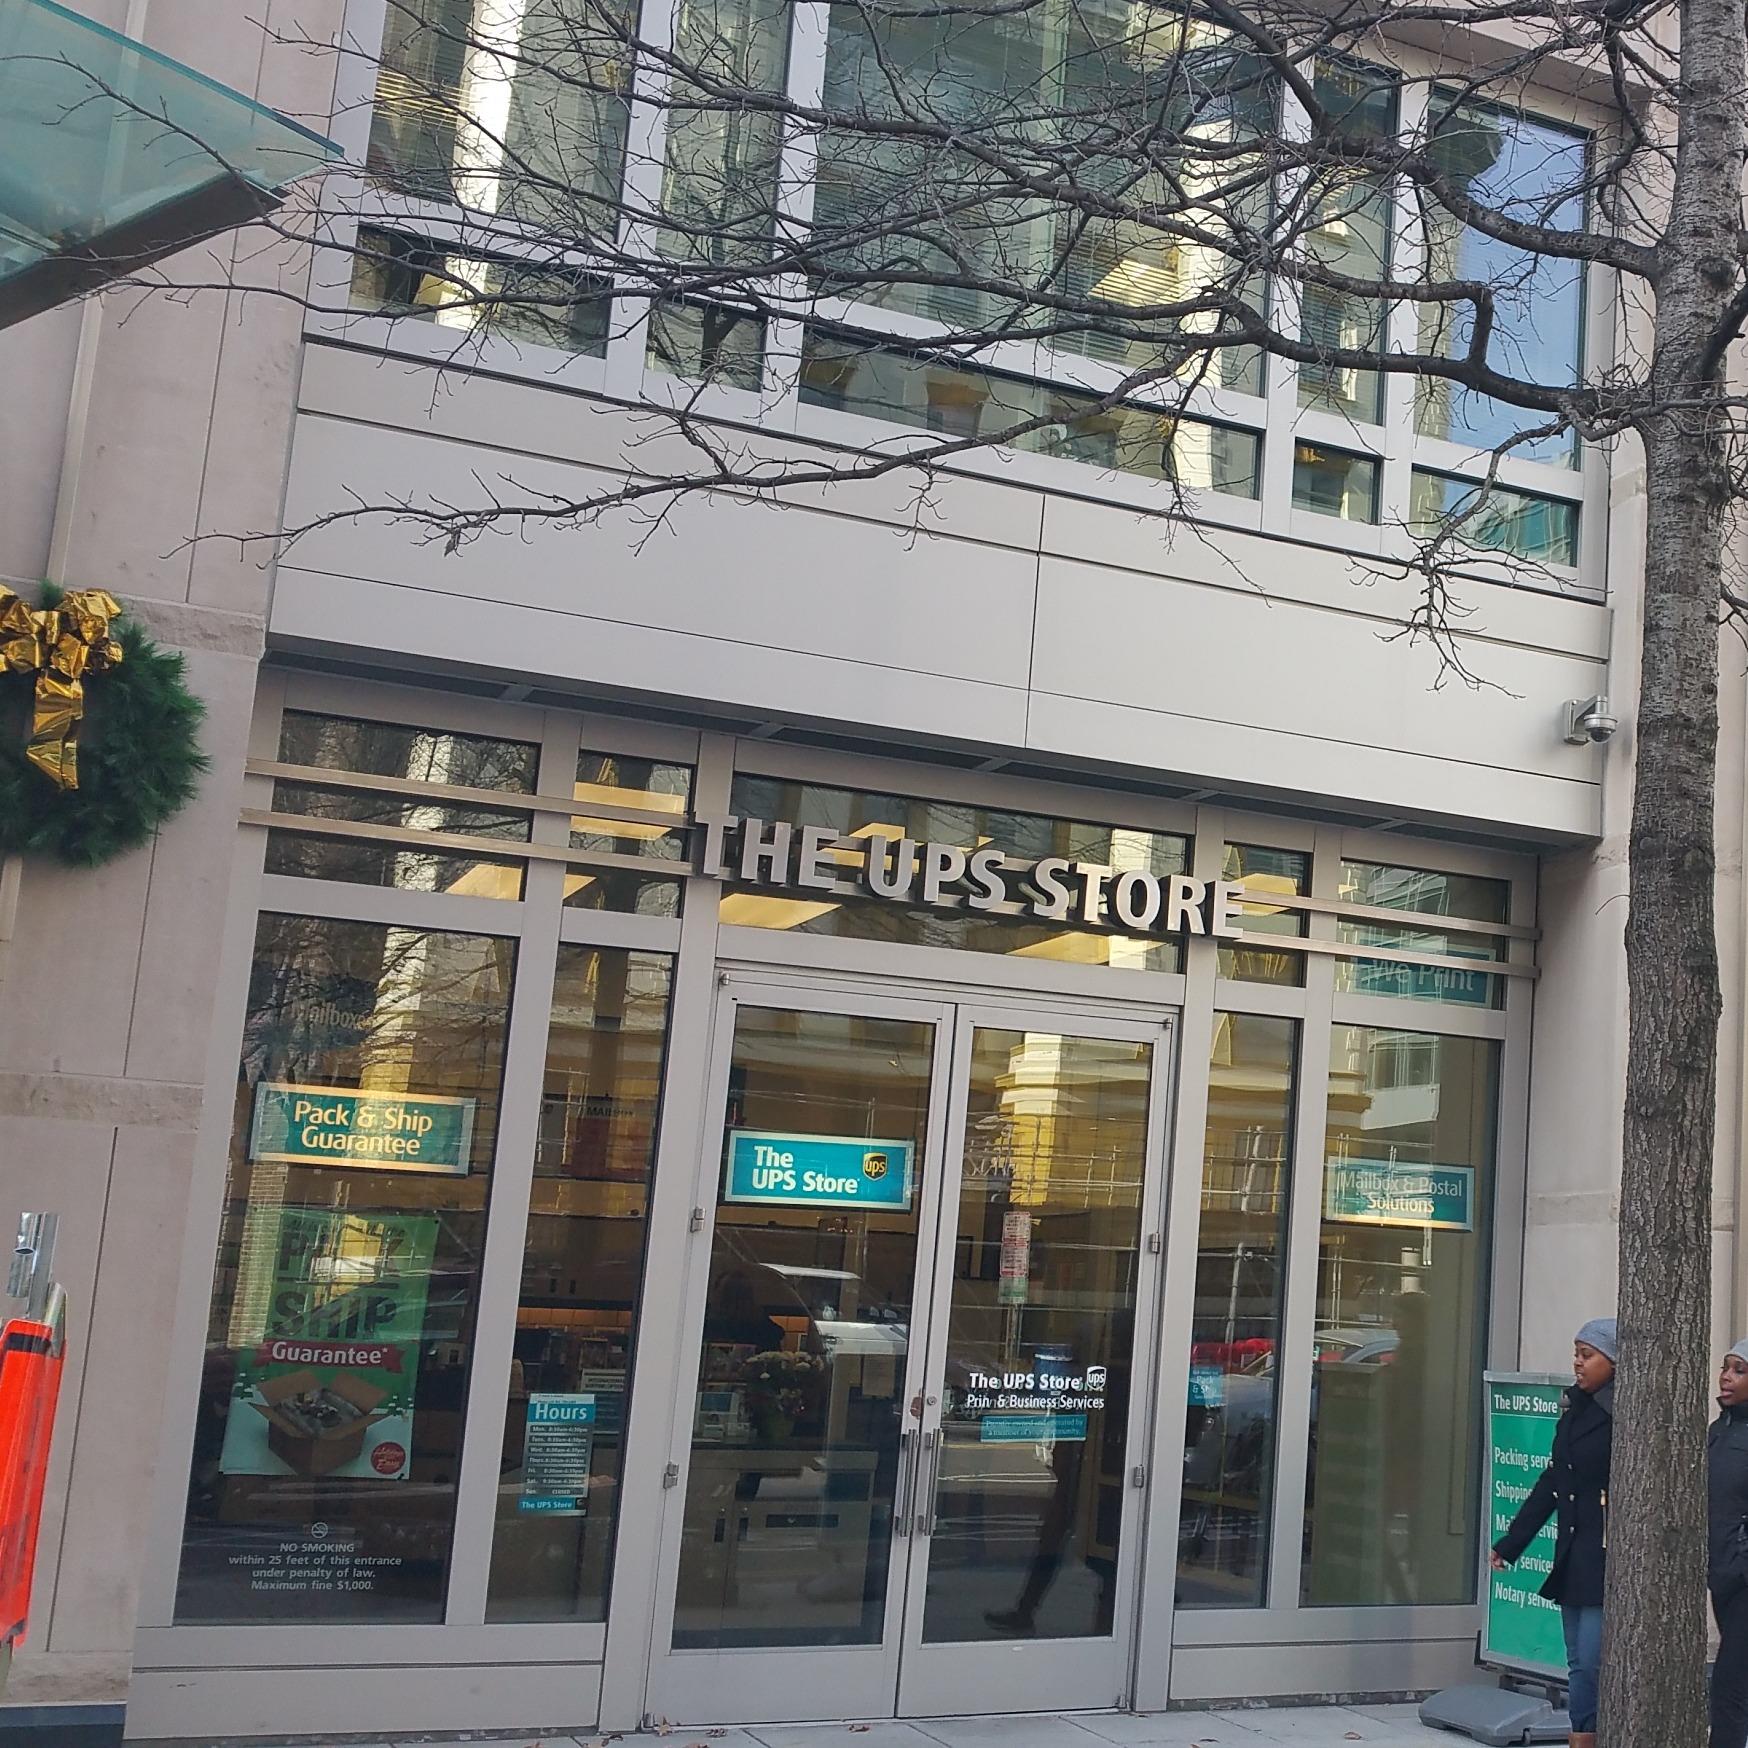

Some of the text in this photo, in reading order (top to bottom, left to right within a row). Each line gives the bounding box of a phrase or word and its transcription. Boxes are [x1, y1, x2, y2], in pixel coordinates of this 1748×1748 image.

[695, 811, 1245, 938] THE UPS STORE
[294, 1100, 433, 1136] Pack & Ship
[301, 1126, 421, 1155] Guarantee
[754, 1145, 886, 1177] The ups
[752, 1168, 859, 1194] UPS Store
[1339, 1170, 1400, 1192] Mailbox
[1419, 1176, 1462, 1197] Postal
[1366, 1191, 1435, 1214] Solutions
[969, 1372, 998, 1389] The
[1003, 1373, 1035, 1390] UPS
[1039, 1373, 1080, 1390] Store
[535, 1401, 588, 1420] Hours
[1009, 1395, 1057, 1409] Business
[1060, 1394, 1105, 1410] Services
[1494, 1394, 1558, 1413] The UPS Store
[1494, 1447, 1529, 1472] Packing
[522, 1501, 573, 1509] The UPS Store
[279, 1543, 355, 1553] NO SMOKING
[228, 1554, 402, 1566] within 25 feet of this entrance
[252, 1568, 376, 1580] under penalty of law.
[250, 1580, 307, 1591] Maximum
[311, 1580, 332, 1590] fine
[1495, 1581, 1526, 1608] Notary
